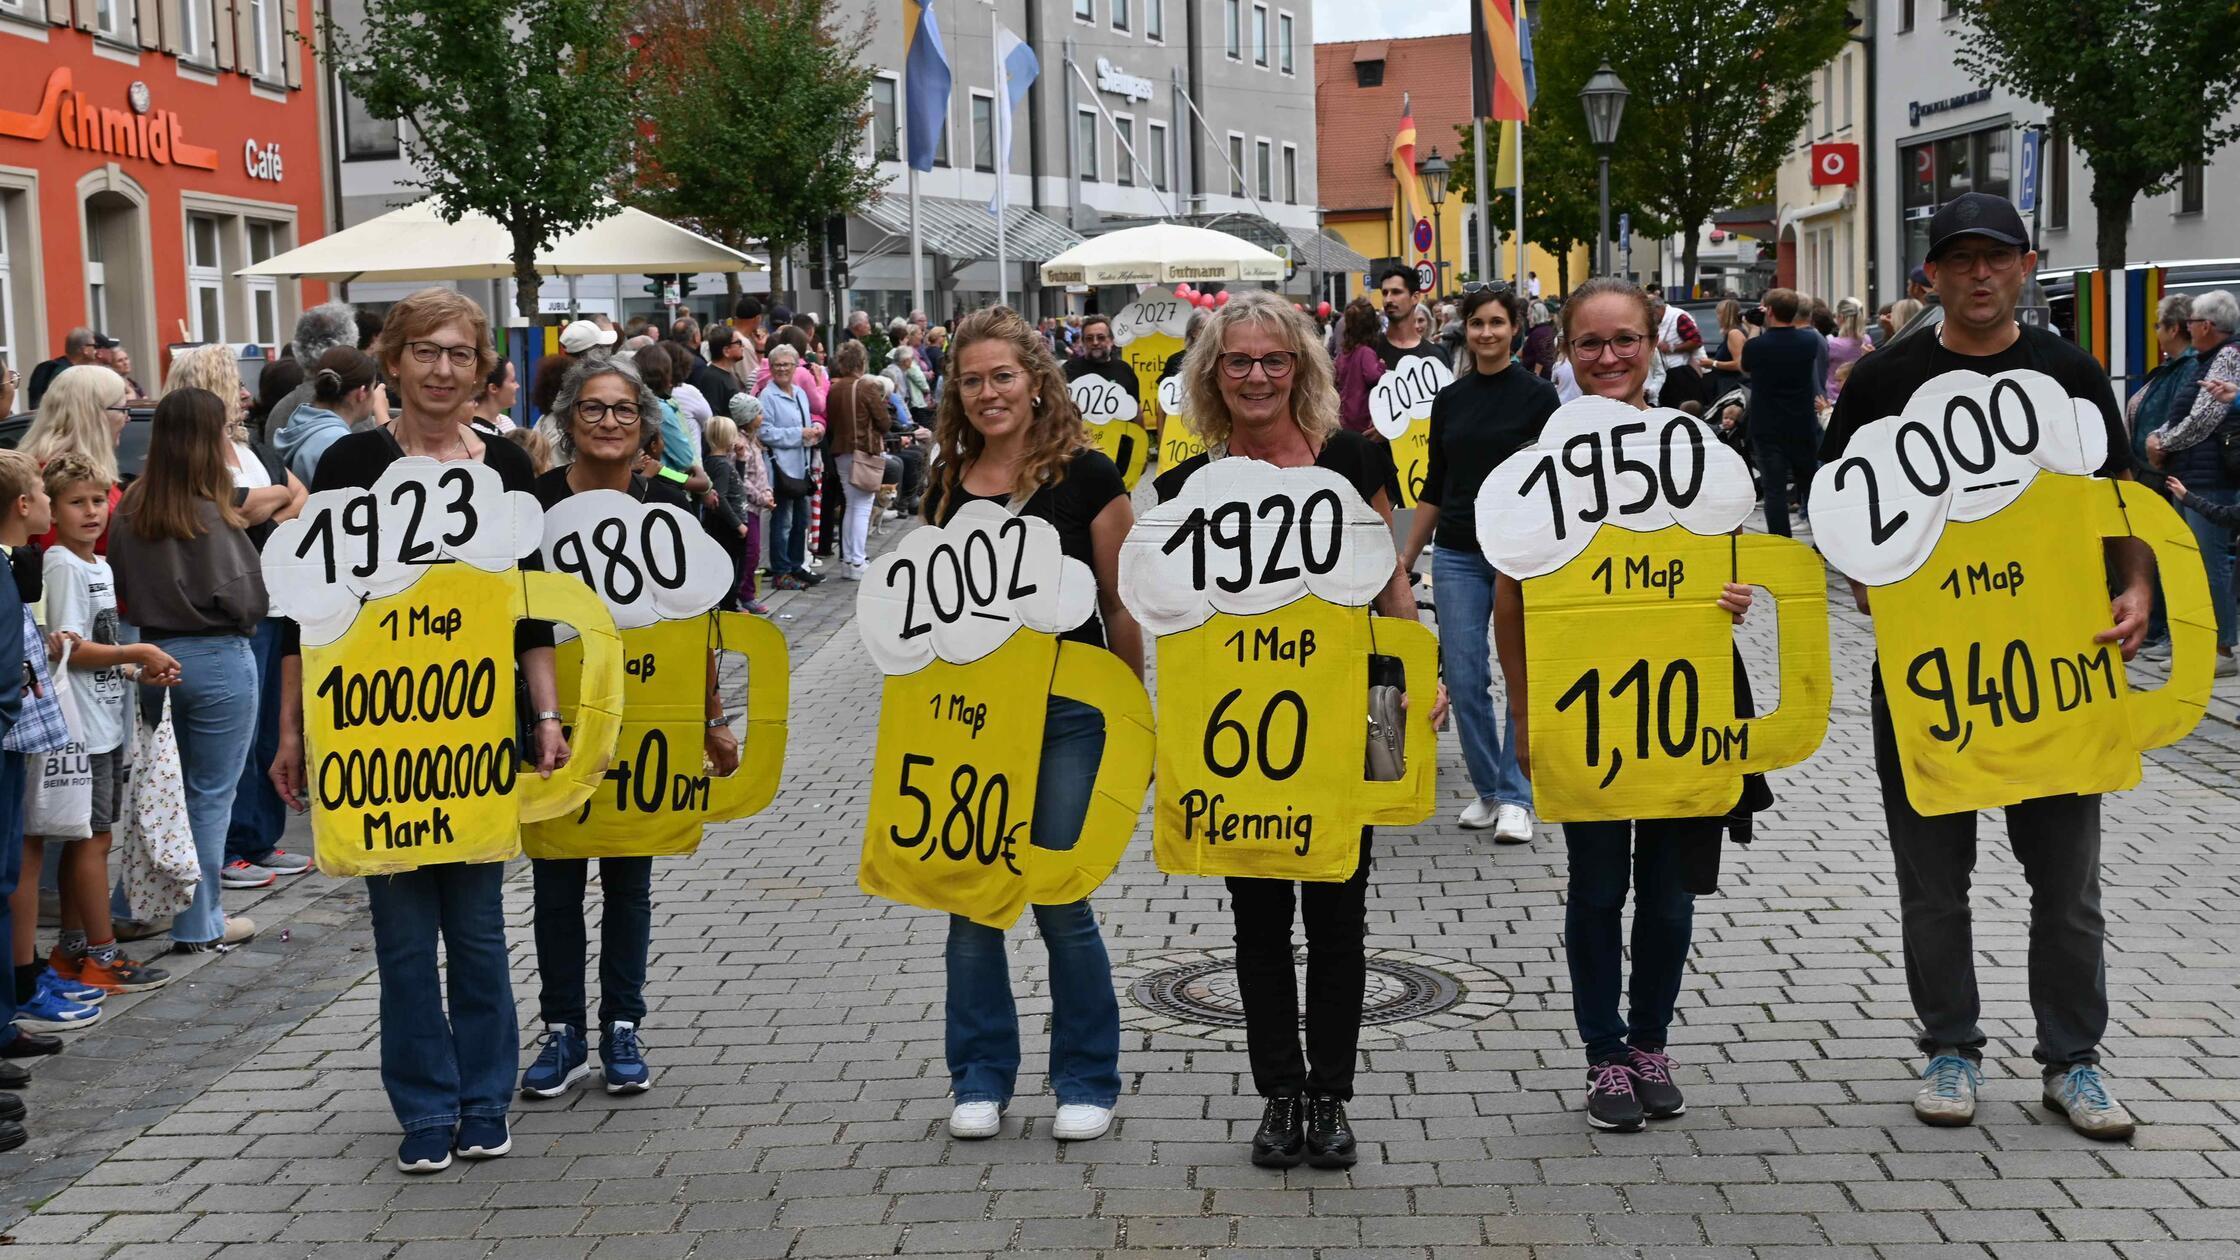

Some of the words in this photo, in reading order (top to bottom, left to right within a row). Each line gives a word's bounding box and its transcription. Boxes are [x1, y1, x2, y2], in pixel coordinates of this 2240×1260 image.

[0, 66, 219, 171] Schmidt
[245, 138, 283, 183] Café
[1169, 265, 1226, 280] Gutmann
[1116, 322, 1129, 337] ab
[1134, 301, 1178, 326] 2027
[1131, 352, 1168, 373] Freib
[1068, 384, 1119, 415] 026
[1379, 361, 1439, 422] 2010
[1517, 415, 1706, 541] 1950
[1833, 378, 2041, 546] 2000
[295, 468, 478, 584] 1923
[1161, 488, 1344, 594] 1920
[552, 508, 687, 605] 980
[886, 517, 1038, 640] 2002
[1592, 557, 1613, 595] 1
[1625, 554, 1685, 599] Maß
[1940, 568, 1962, 599] 1
[1966, 560, 2025, 597] Maß
[379, 609, 399, 641] 1
[408, 604, 462, 642] Maß
[622, 652, 656, 683] aß
[1225, 629, 1246, 663] 1
[1254, 626, 1317, 668] Maß
[930, 693, 942, 720] 1
[948, 694, 987, 740] Maß
[1906, 638, 2041, 754] 9,40
[2050, 646, 2118, 712] DM
[1203, 687, 1308, 782] 60
[1554, 658, 1700, 790] 1,10
[1701, 722, 1749, 766] DM
[43, 778, 69, 789] BEIM
[71, 777, 92, 786] ROT
[671, 773, 711, 812] DM
[363, 807, 455, 851] Mark
[1178, 788, 1314, 857] Pfennig
